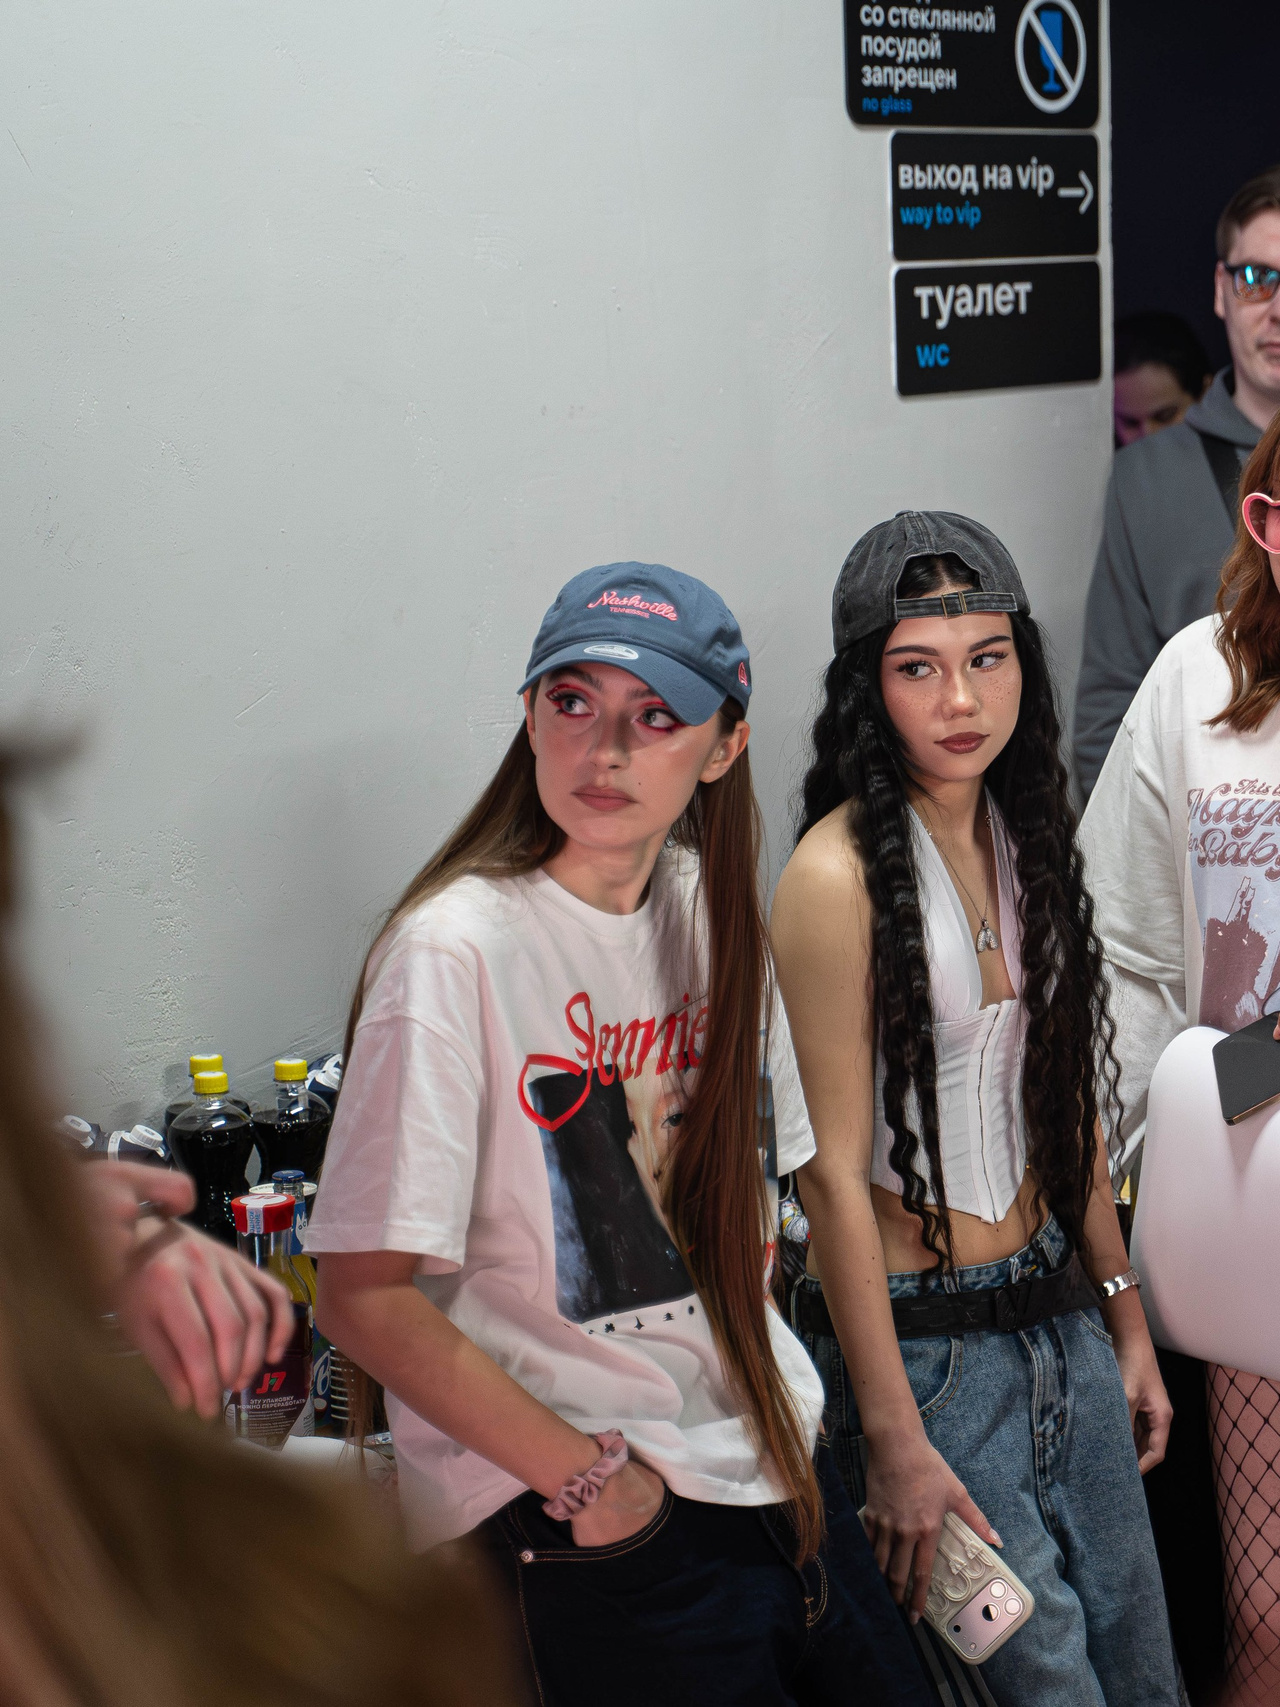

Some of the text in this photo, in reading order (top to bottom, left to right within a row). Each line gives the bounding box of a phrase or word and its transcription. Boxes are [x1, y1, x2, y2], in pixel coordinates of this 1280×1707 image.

[860, 4, 996, 33] со стеклянной
[861, 32, 942, 64] посудой
[861, 65, 957, 94] запрещен
[862, 94, 913, 116] no glass
[898, 156, 1055, 198] выход на vip
[900, 200, 982, 230] way to vip
[913, 281, 1033, 330] туалет
[586, 591, 679, 621] Nashville
[609, 606, 651, 619] TENNESSEE
[1234, 778, 1272, 795] This
[518, 991, 709, 1132] Jennie
[256, 1371, 287, 1395] J7
